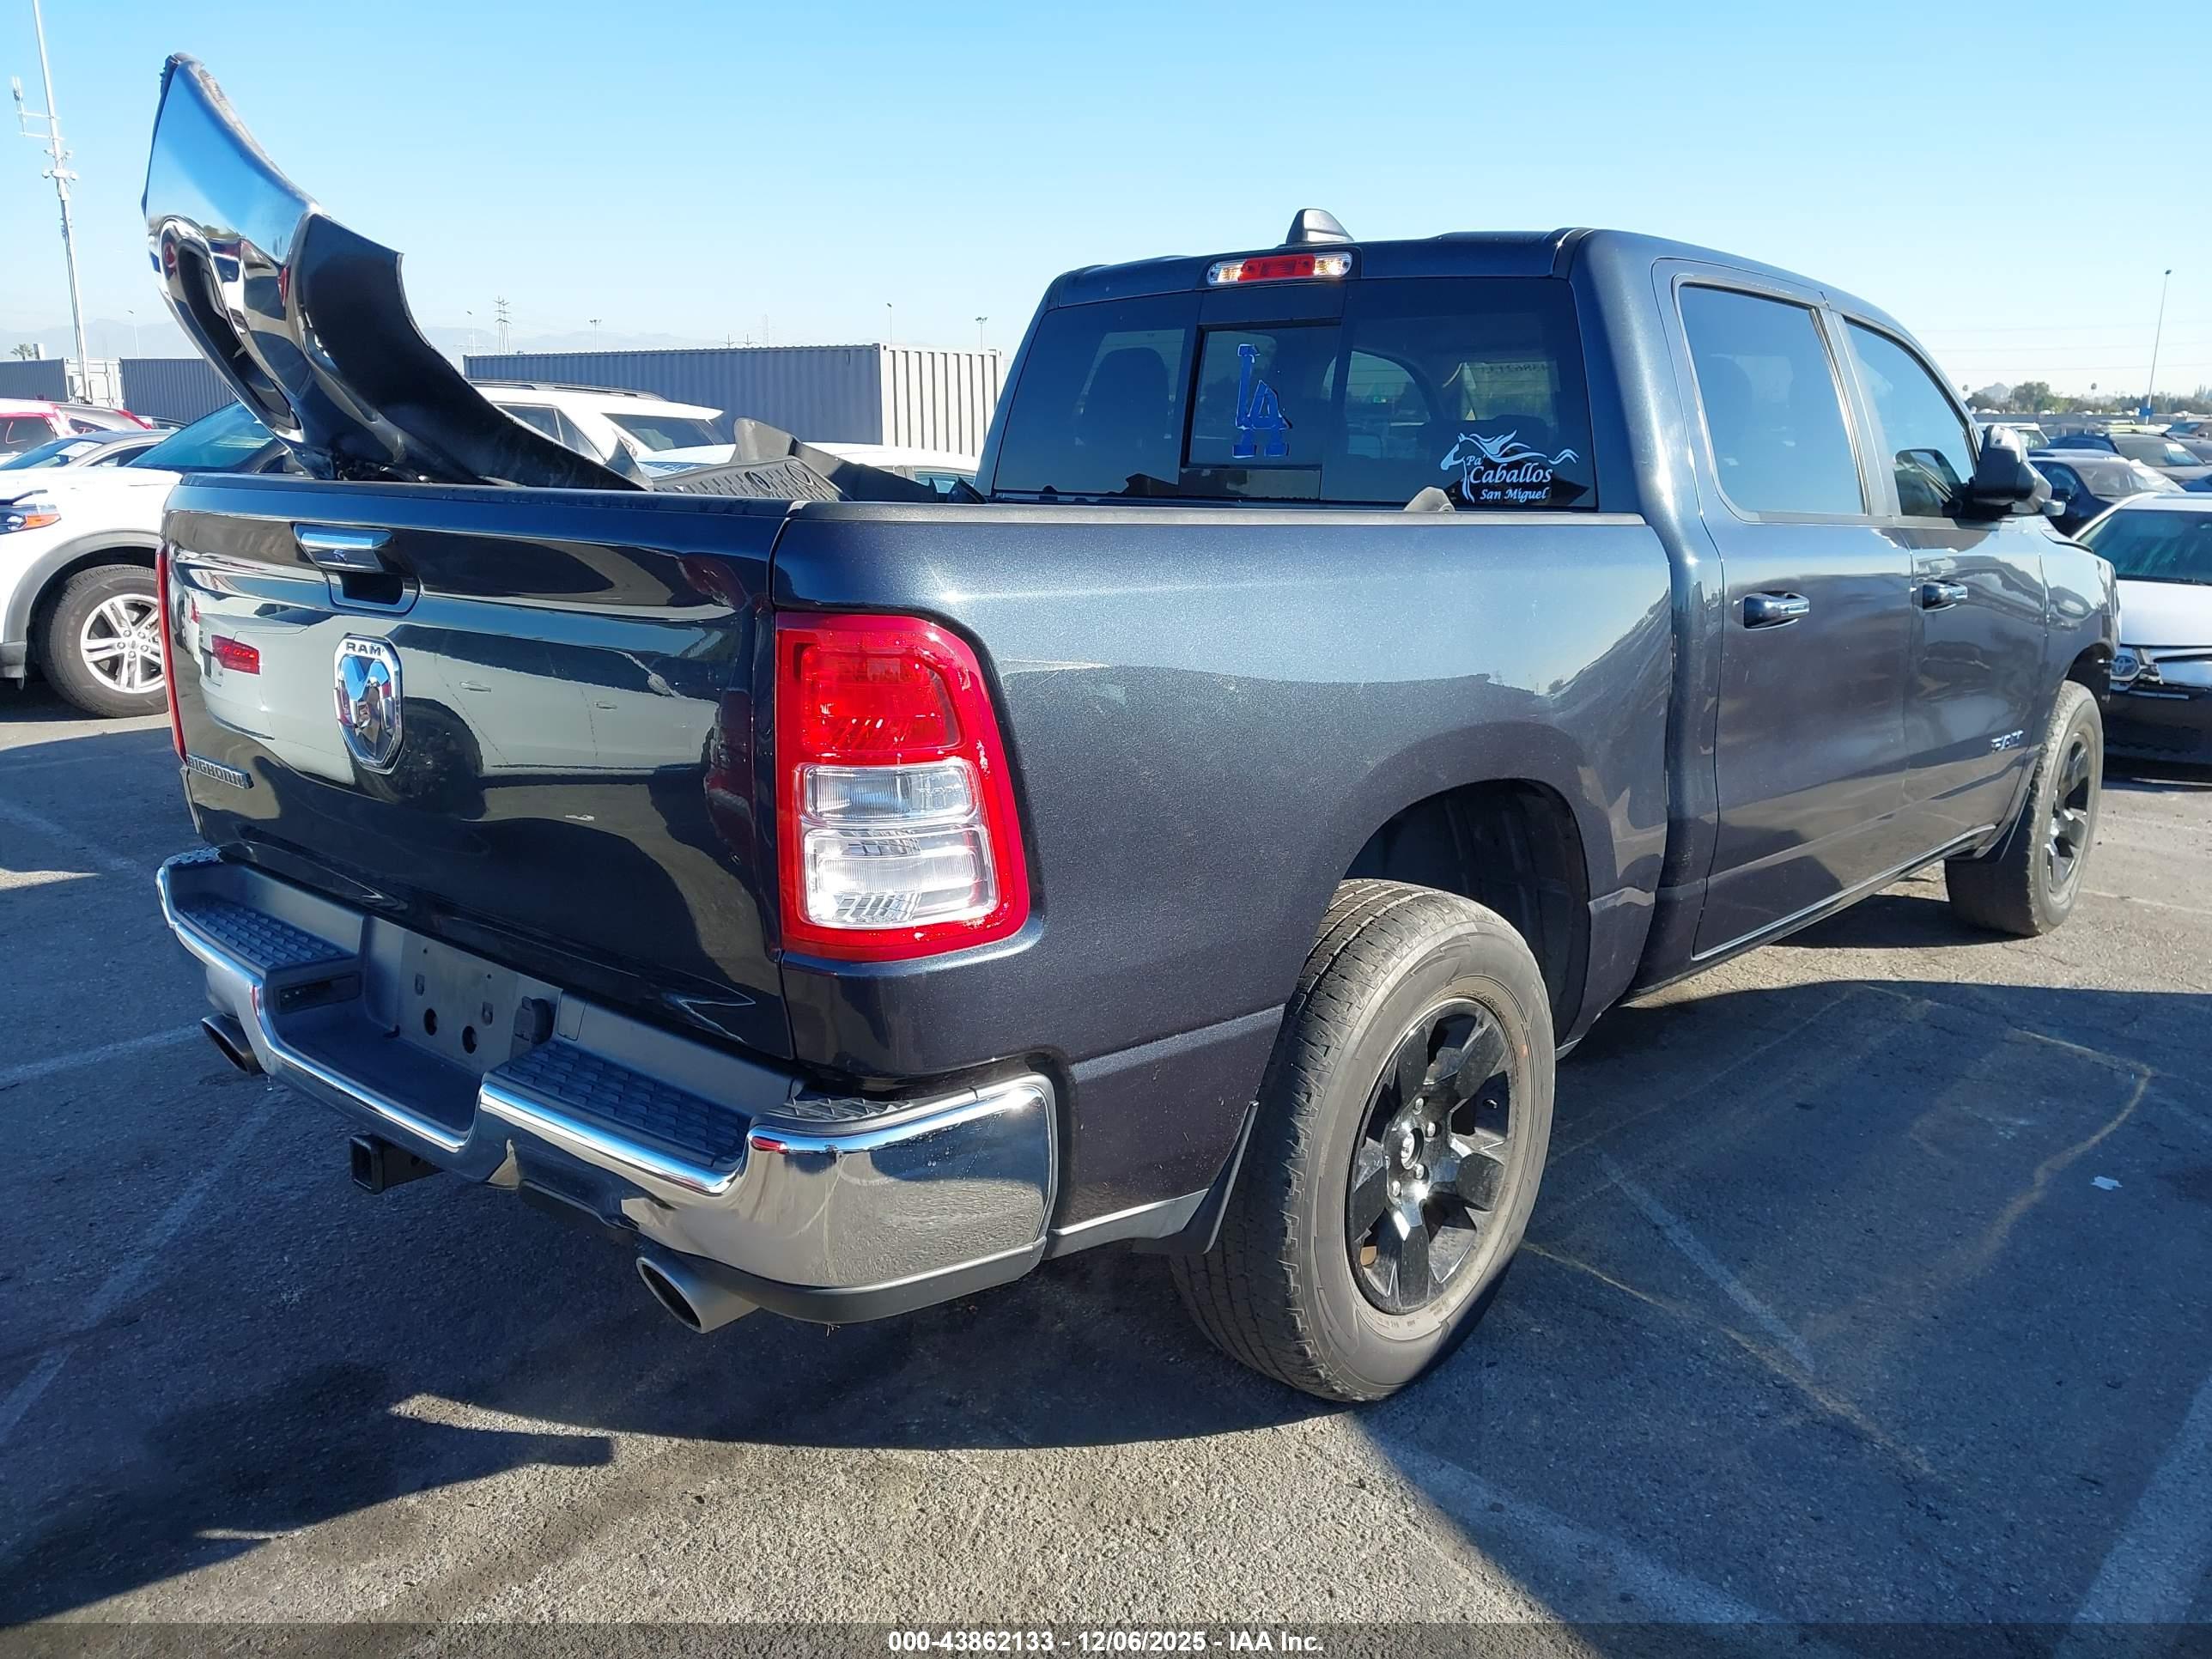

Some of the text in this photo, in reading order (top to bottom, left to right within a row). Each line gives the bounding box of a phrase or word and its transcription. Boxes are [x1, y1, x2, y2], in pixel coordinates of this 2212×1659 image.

[1232, 343, 1291, 459] LA
[1469, 462, 1553, 484] Caballos
[1480, 487, 1550, 503] San Miguel
[345, 641, 381, 657] RAM
